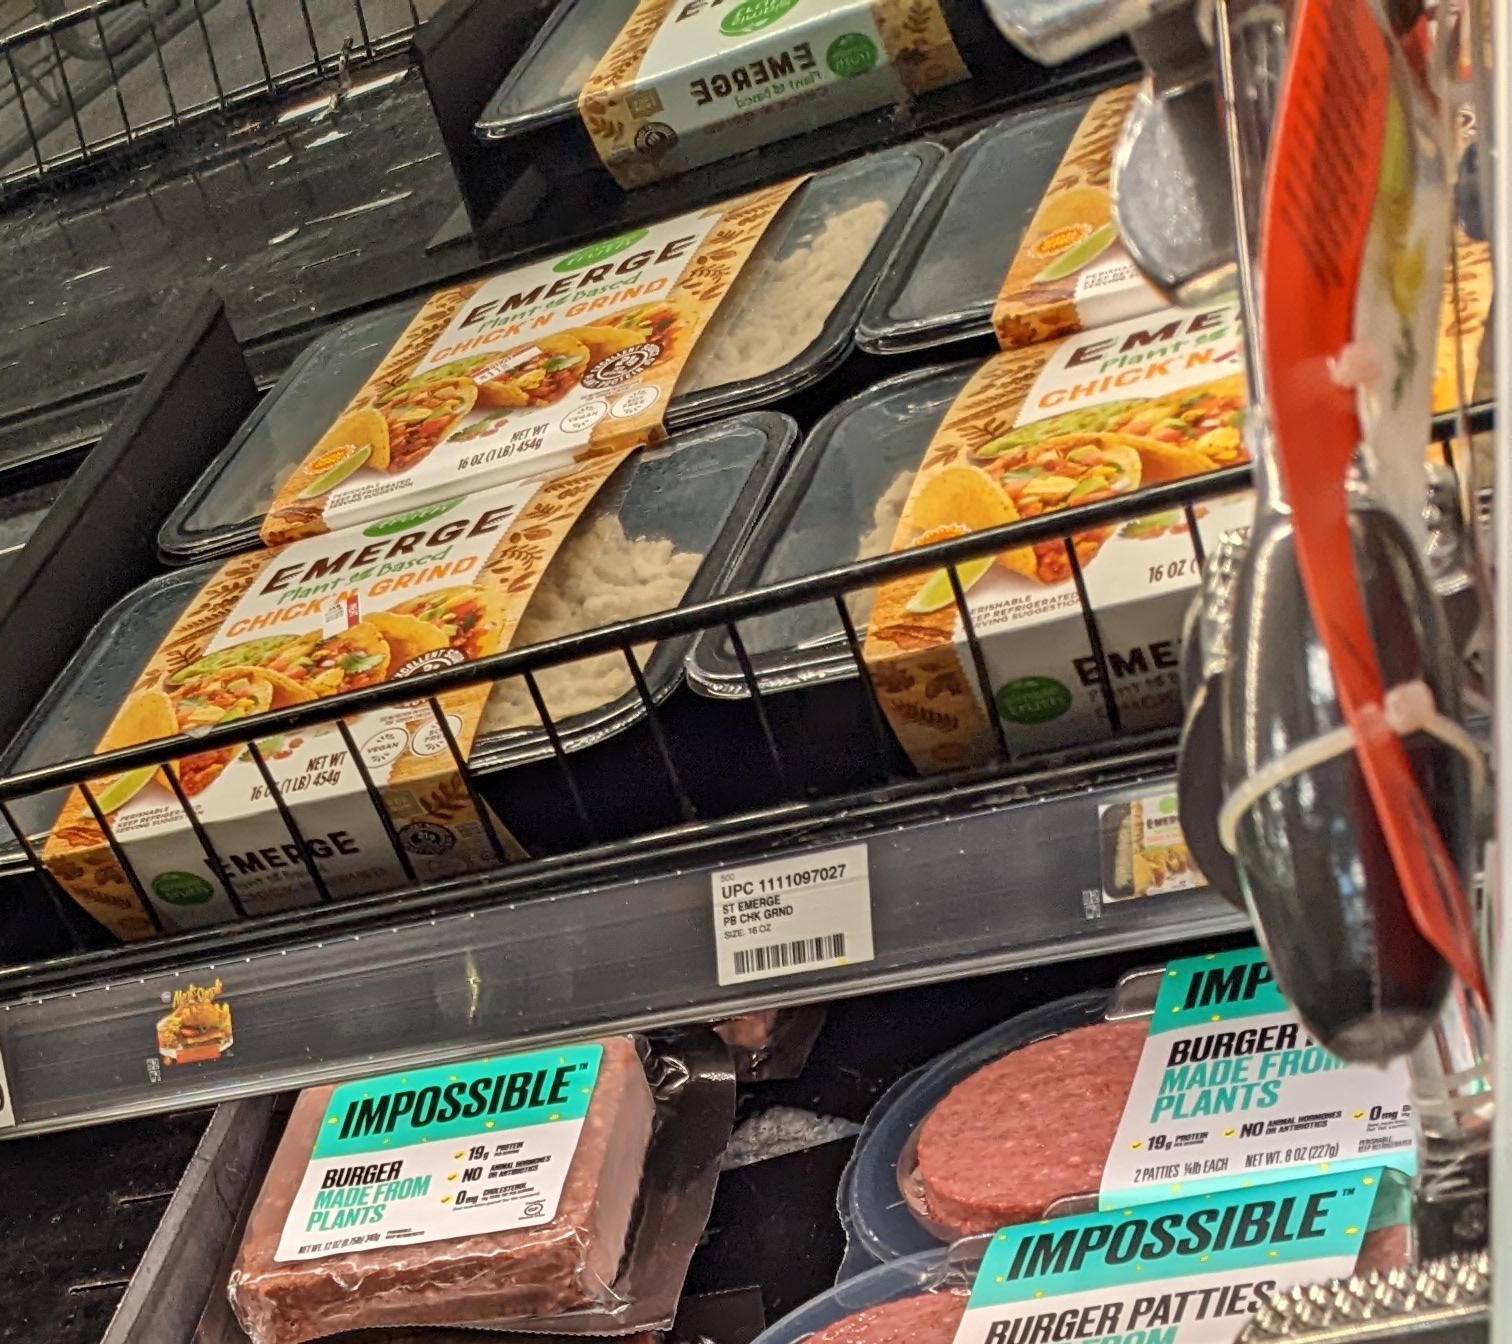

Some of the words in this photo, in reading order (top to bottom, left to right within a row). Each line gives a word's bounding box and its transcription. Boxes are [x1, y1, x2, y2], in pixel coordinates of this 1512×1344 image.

[457, 234, 697, 329] EMERGE
[429, 314, 553, 363] CHICK'N
[565, 278, 667, 320] GRIND
[1038, 351, 1213, 410] CHICK'N
[261, 504, 517, 595] EMERGE
[368, 556, 480, 599] GRIND
[721, 880, 754, 899] UPC
[759, 865, 847, 894] 1111097027
[722, 903, 735, 915] ST
[737, 895, 781, 913] EMERGE
[724, 915, 736, 927] PB
[739, 911, 761, 925] CHK
[764, 905, 794, 921] GRND
[1168, 1024, 1298, 1067] BURGER
[1160, 1056, 1248, 1094] MADE
[338, 1064, 577, 1140] IMPOSSIBLE
[1150, 1080, 1282, 1123] PLANTS
[323, 1161, 403, 1189] BURGER
[1143, 1163, 1179, 1182] PATTIES
[1203, 1157, 1228, 1174] EACH
[1245, 1152, 1264, 1168] NET
[1293, 1146, 1305, 1161] OZ
[1307, 1142, 1339, 1161] (227g)
[313, 1182, 375, 1209] MADE
[375, 1175, 430, 1200] FROM
[306, 1205, 386, 1232] PLANTS
[1007, 1191, 1337, 1281] IMPOSSIBLE
[1127, 1280, 1276, 1330] PATTIES
